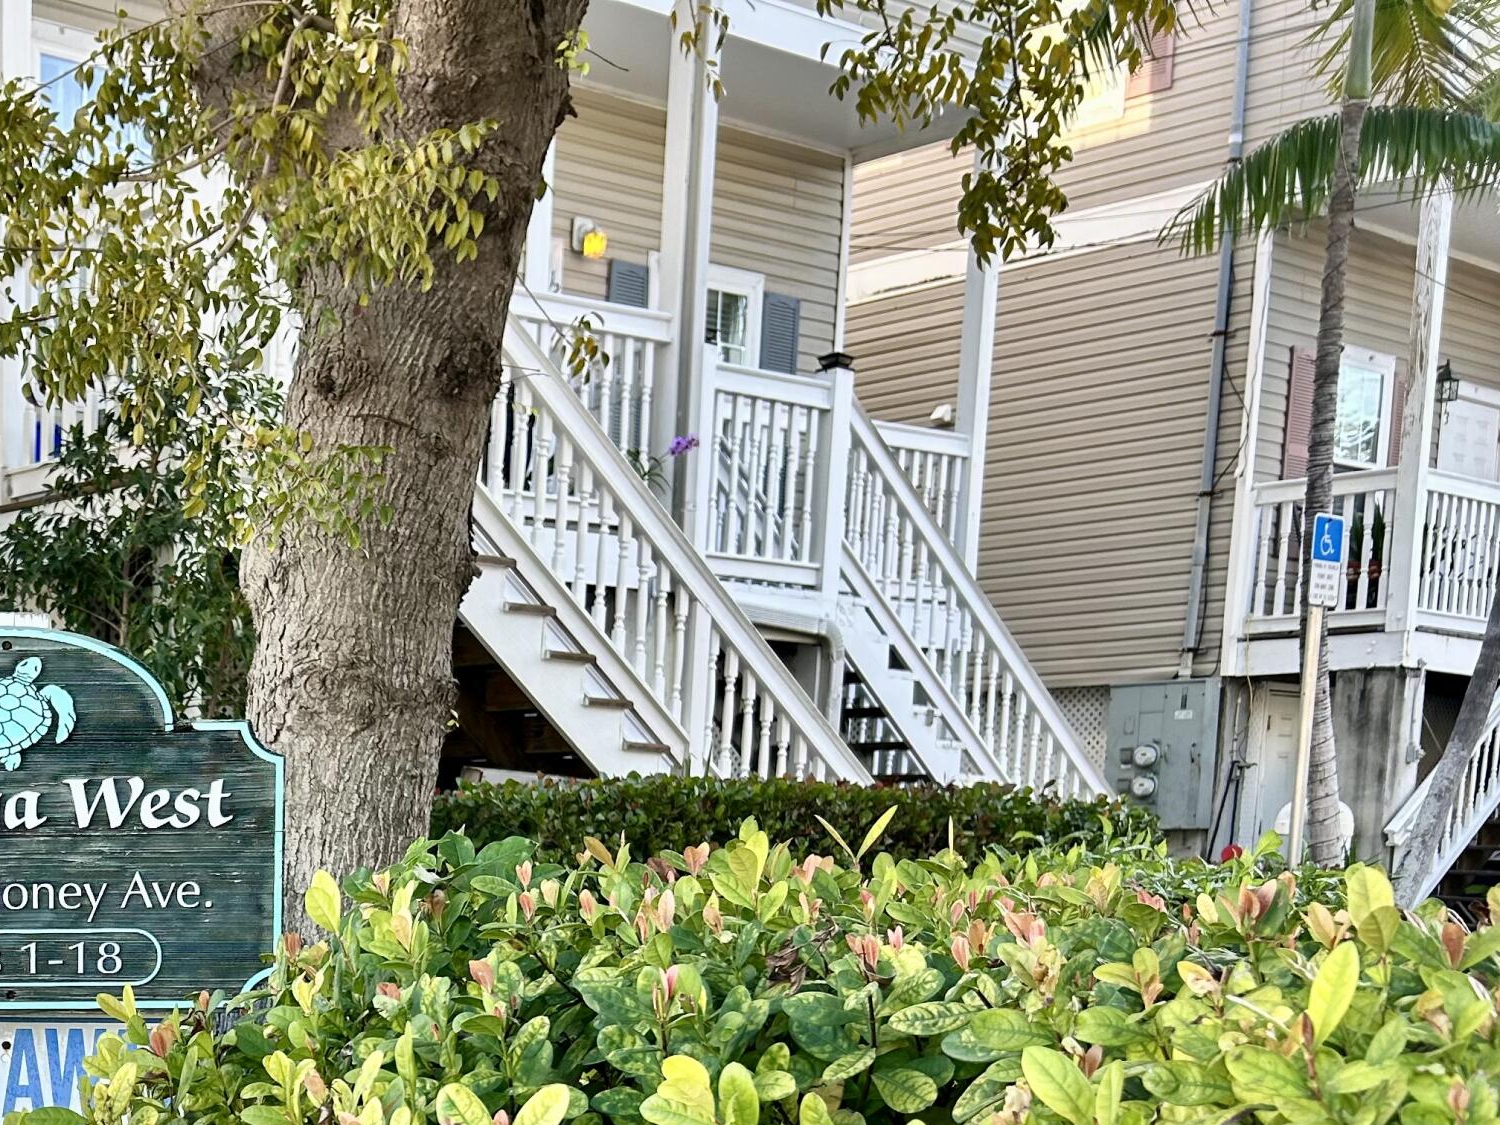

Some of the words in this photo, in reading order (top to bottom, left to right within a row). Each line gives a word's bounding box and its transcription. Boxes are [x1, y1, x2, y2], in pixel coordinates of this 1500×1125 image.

[63, 775, 234, 830] West
[120, 870, 212, 909] Ave.
[20, 941, 122, 975] 1-18
